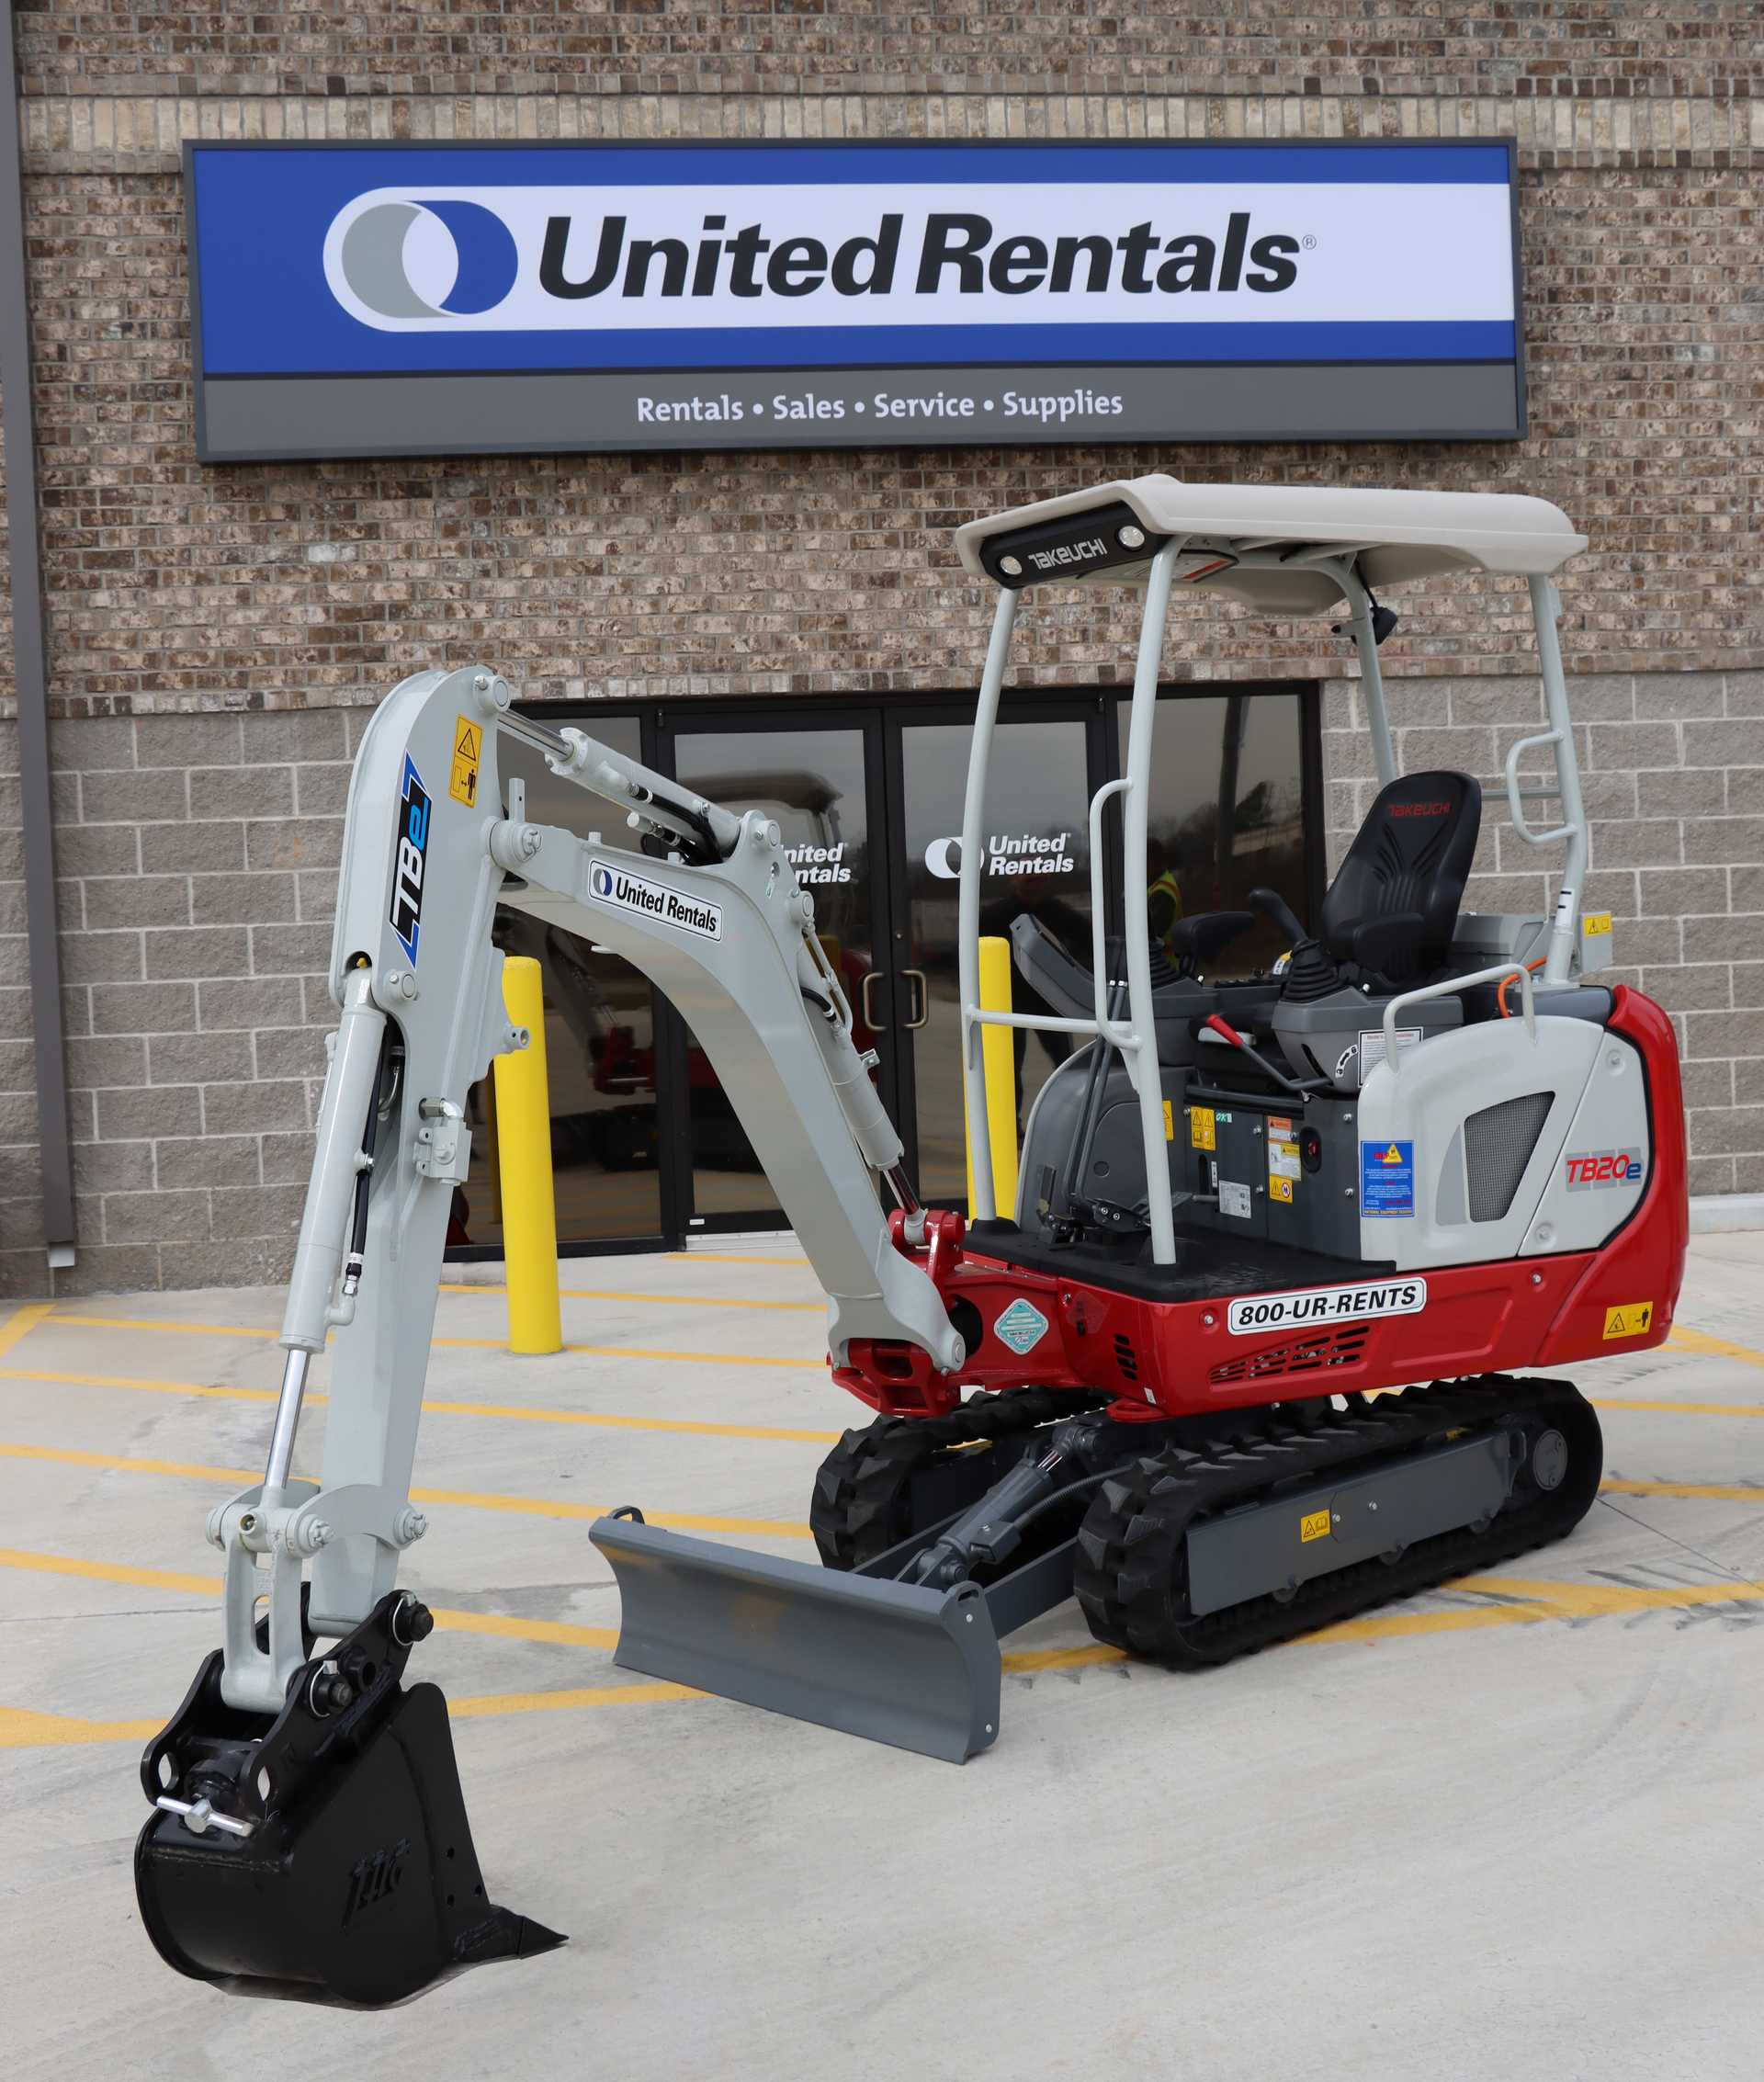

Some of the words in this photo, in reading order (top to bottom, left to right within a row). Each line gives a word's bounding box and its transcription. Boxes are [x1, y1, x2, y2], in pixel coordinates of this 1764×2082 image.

[538, 212, 904, 300] United
[915, 211, 1300, 296] Rentals
[637, 395, 744, 424] Rentals
[773, 393, 845, 421] Sales
[875, 391, 976, 419] Service
[1003, 389, 1124, 423] Supplies
[1028, 537, 1108, 570] TAKEUCHI
[1387, 801, 1451, 818] TAKEUCHI
[781, 842, 845, 864] nited
[989, 832, 1068, 855] United
[794, 863, 852, 884] ntals
[989, 854, 1075, 877] Rentals
[616, 876, 665, 914] United
[667, 894, 717, 933] Rentals
[1216, 1112, 1227, 1122] OK
[1566, 1153, 1642, 1183] TB20e
[1238, 1285, 1417, 1326] 800-UR-RENTS
